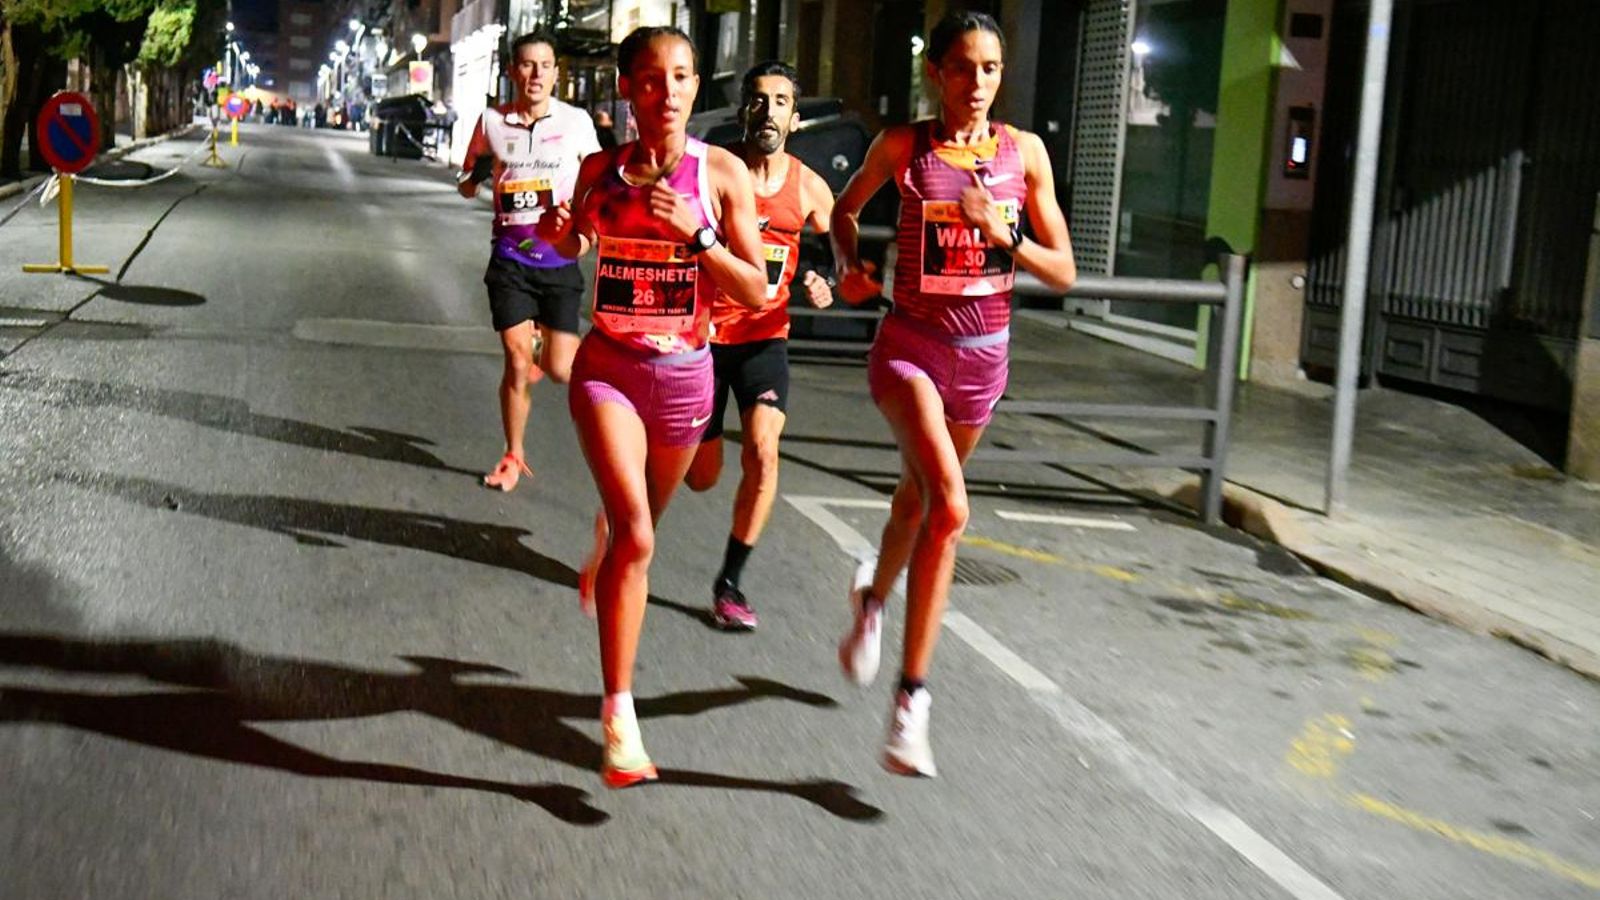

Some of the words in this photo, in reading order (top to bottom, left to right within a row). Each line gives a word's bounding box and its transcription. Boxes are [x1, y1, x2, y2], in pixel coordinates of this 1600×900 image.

[513, 190, 538, 209] 59
[936, 227, 995, 249] WAL
[964, 250, 986, 267] 30
[600, 264, 696, 282] ALEMESHETE
[632, 289, 655, 306] 26
